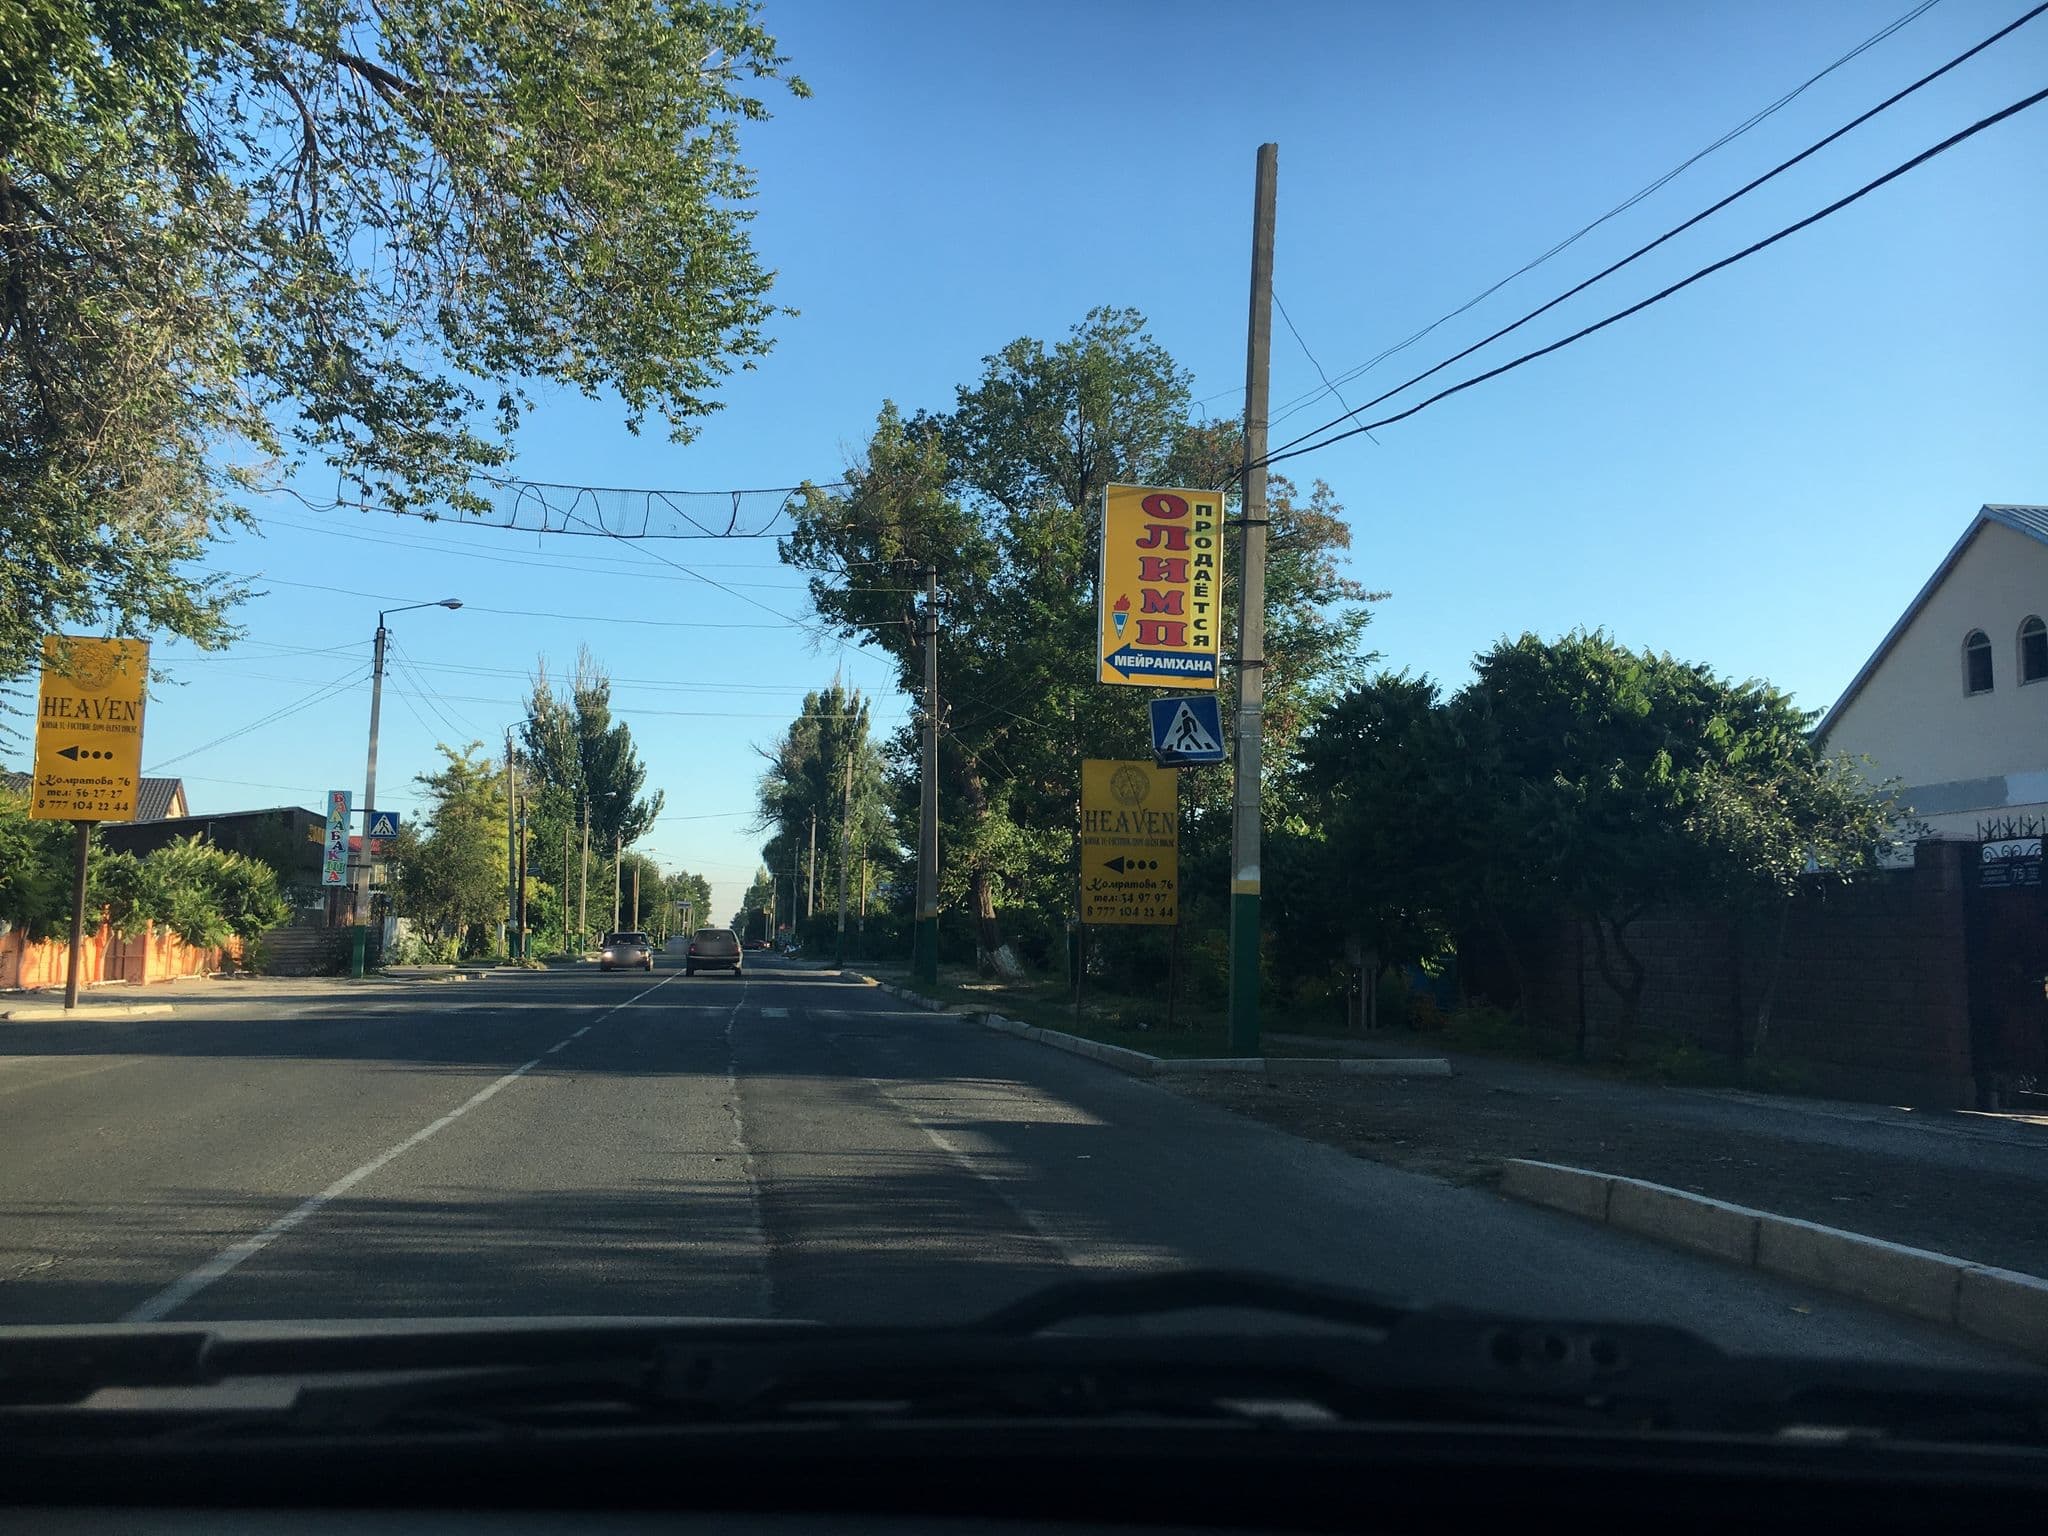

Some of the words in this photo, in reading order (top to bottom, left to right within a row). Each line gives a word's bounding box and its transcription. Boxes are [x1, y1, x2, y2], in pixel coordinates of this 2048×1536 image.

[1135, 493, 1190, 647] ОЛИМП
[1193, 504, 1214, 647] ПРОДАЁТСЯ
[1114, 653, 1213, 672] МЕЙРАМХАНА
[43, 696, 137, 721] HEAVEN
[118, 777, 131, 787] 76
[38, 800, 45, 809] 8
[49, 801, 69, 809] 777
[72, 801, 93, 811] 104
[98, 802, 109, 811] 22
[113, 802, 129, 812] 44
[1084, 808, 1175, 833] HEAVEN
[1160, 879, 1174, 890] 76
[1096, 906, 1116, 916] 777
[1119, 906, 1140, 917] 104
[1159, 906, 1174, 918] 44
